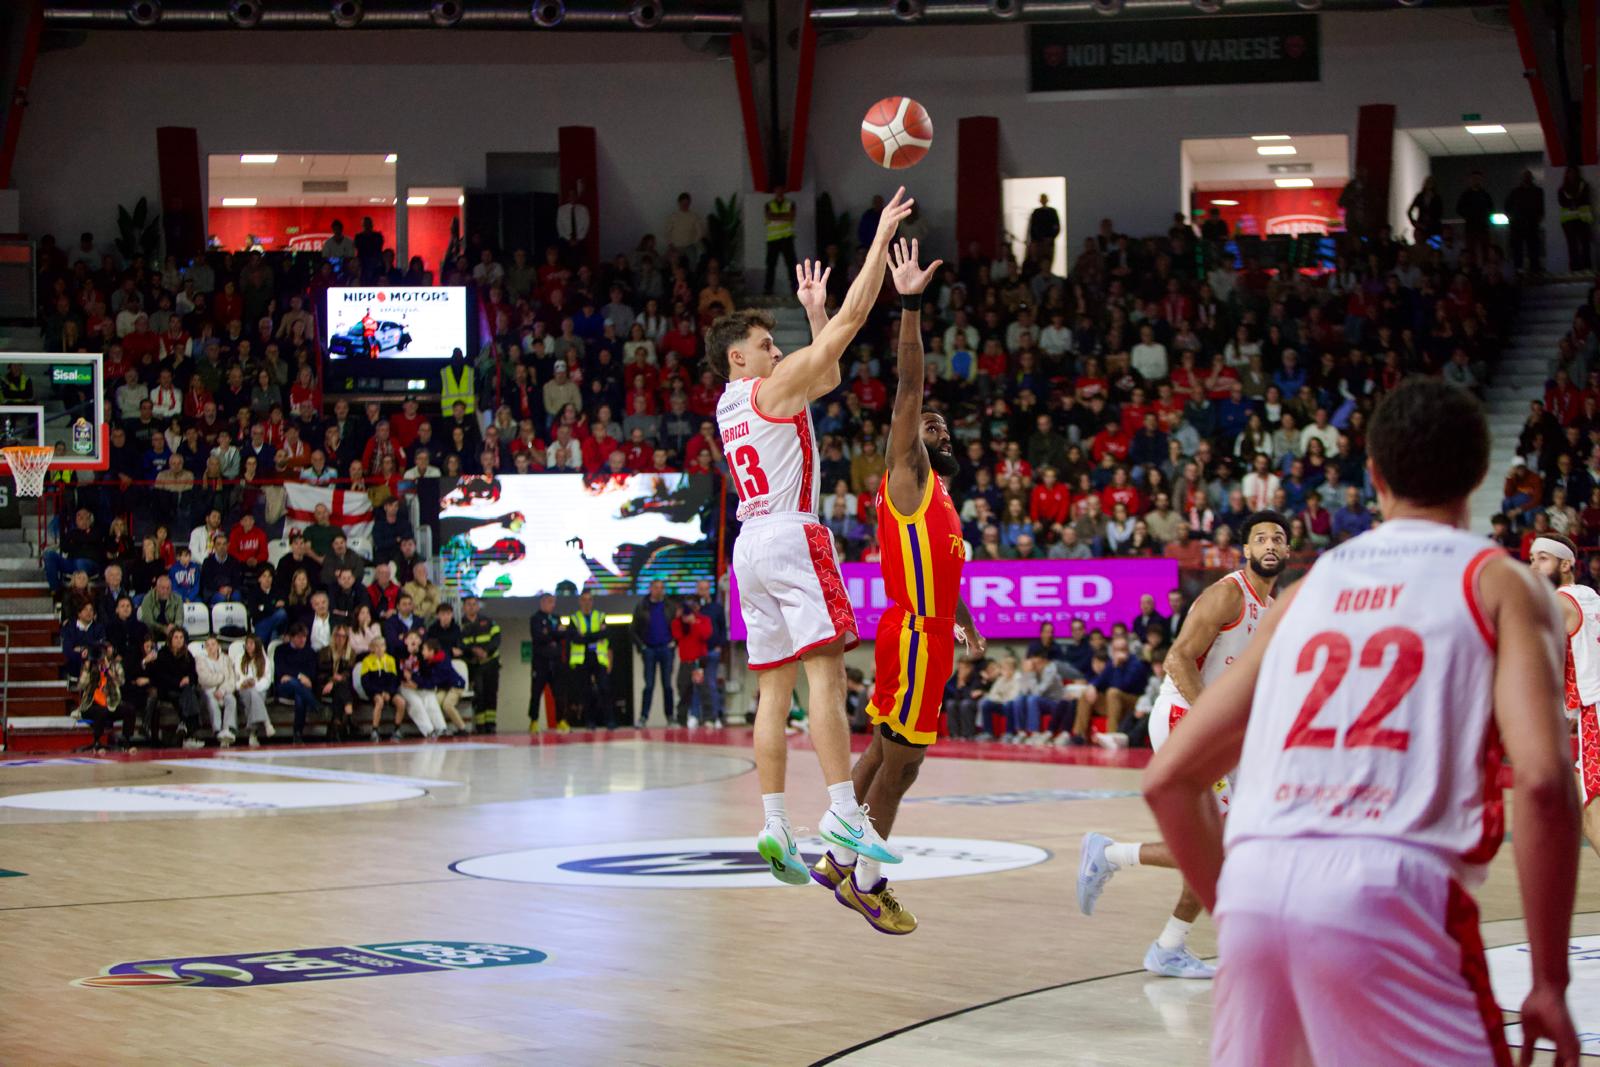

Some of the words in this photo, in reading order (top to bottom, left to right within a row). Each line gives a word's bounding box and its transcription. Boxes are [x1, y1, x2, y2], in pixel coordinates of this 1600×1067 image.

[1067, 44, 1105, 67] NOI
[1112, 41, 1186, 65] SIAMO
[1191, 36, 1281, 62] VARESE
[390, 291, 449, 302] MOTORS
[727, 445, 769, 503] 13
[1334, 583, 1405, 613] ROBY
[998, 611, 1110, 623] SEMPRE
[1284, 626, 1425, 752] 22
